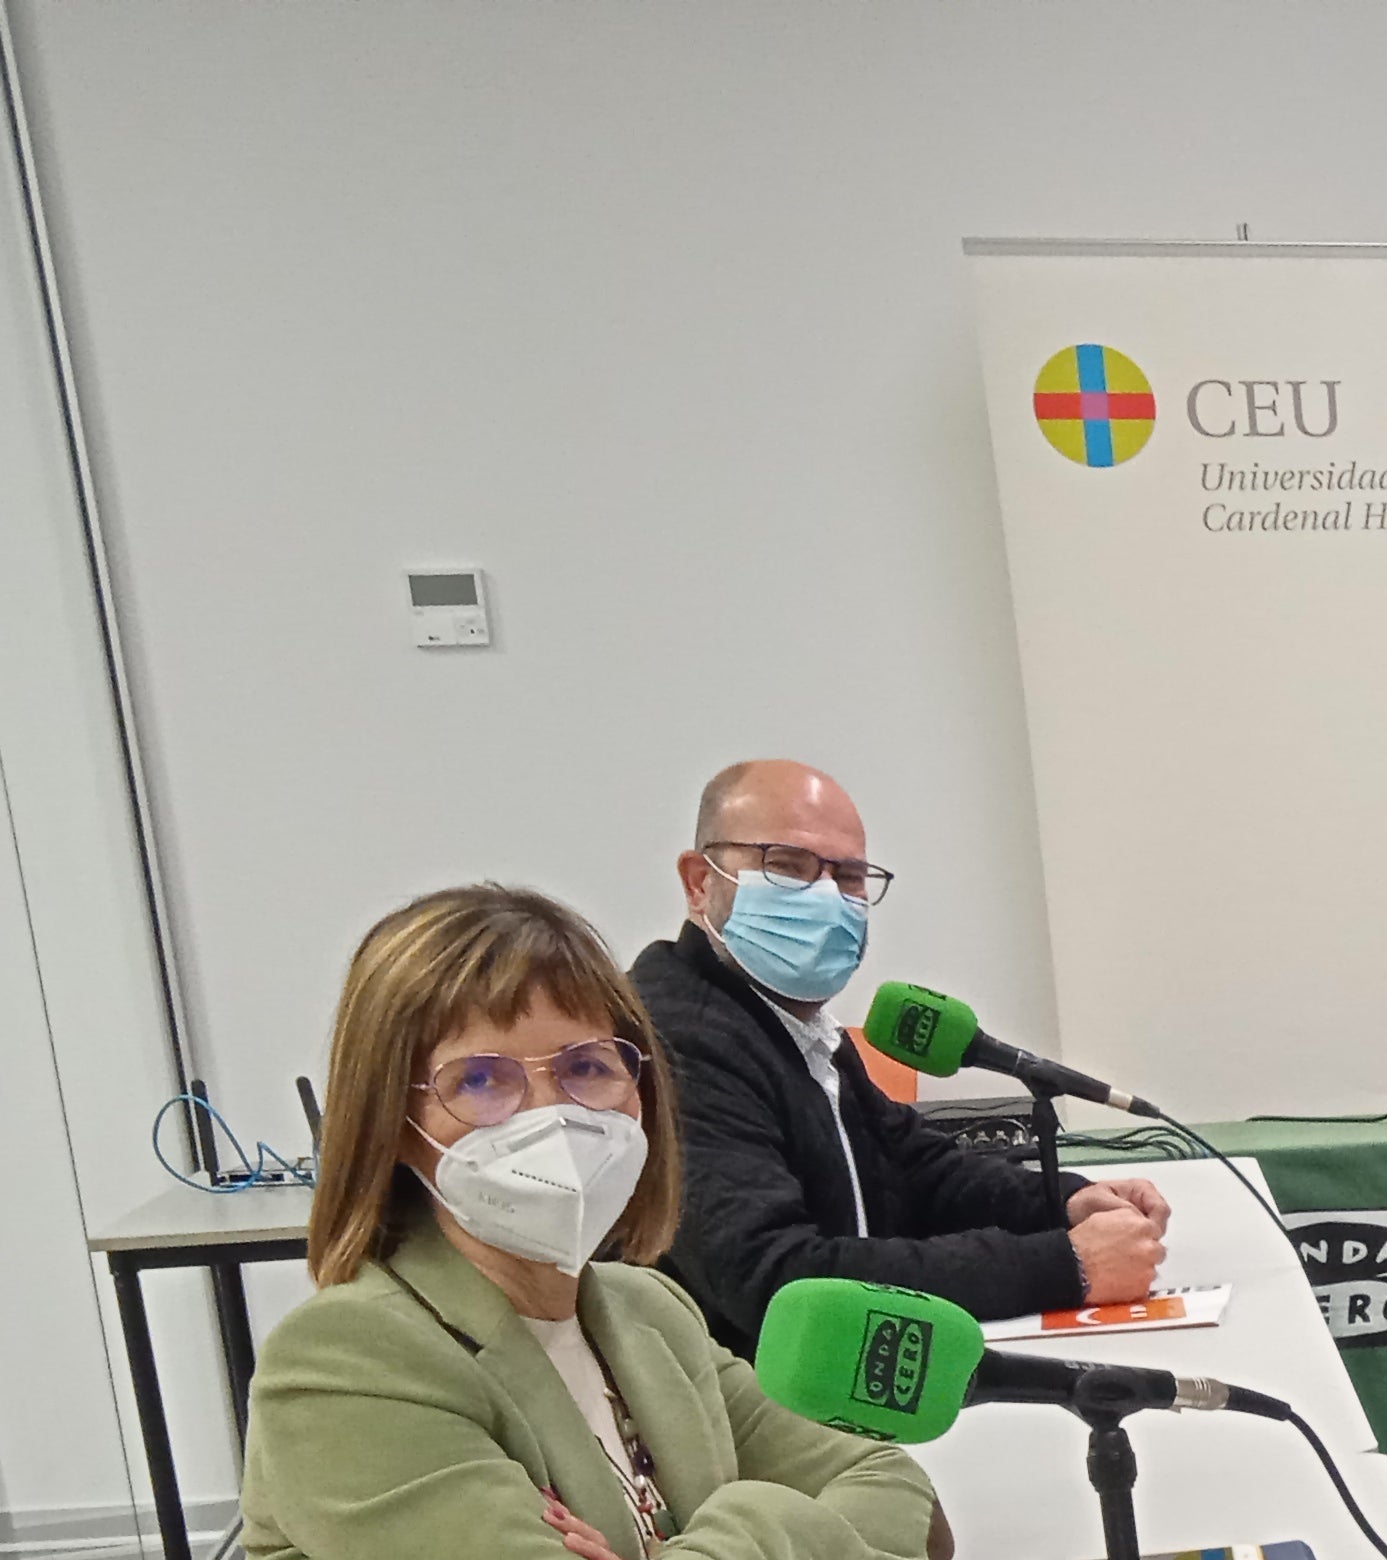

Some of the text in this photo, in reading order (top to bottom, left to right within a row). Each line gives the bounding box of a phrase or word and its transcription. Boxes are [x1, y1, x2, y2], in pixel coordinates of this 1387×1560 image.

[1186, 378, 1342, 438] CEU
[1202, 501, 1353, 532] Cardenal
[869, 1328, 896, 1392] ONDA
[895, 1331, 920, 1395] CERO
